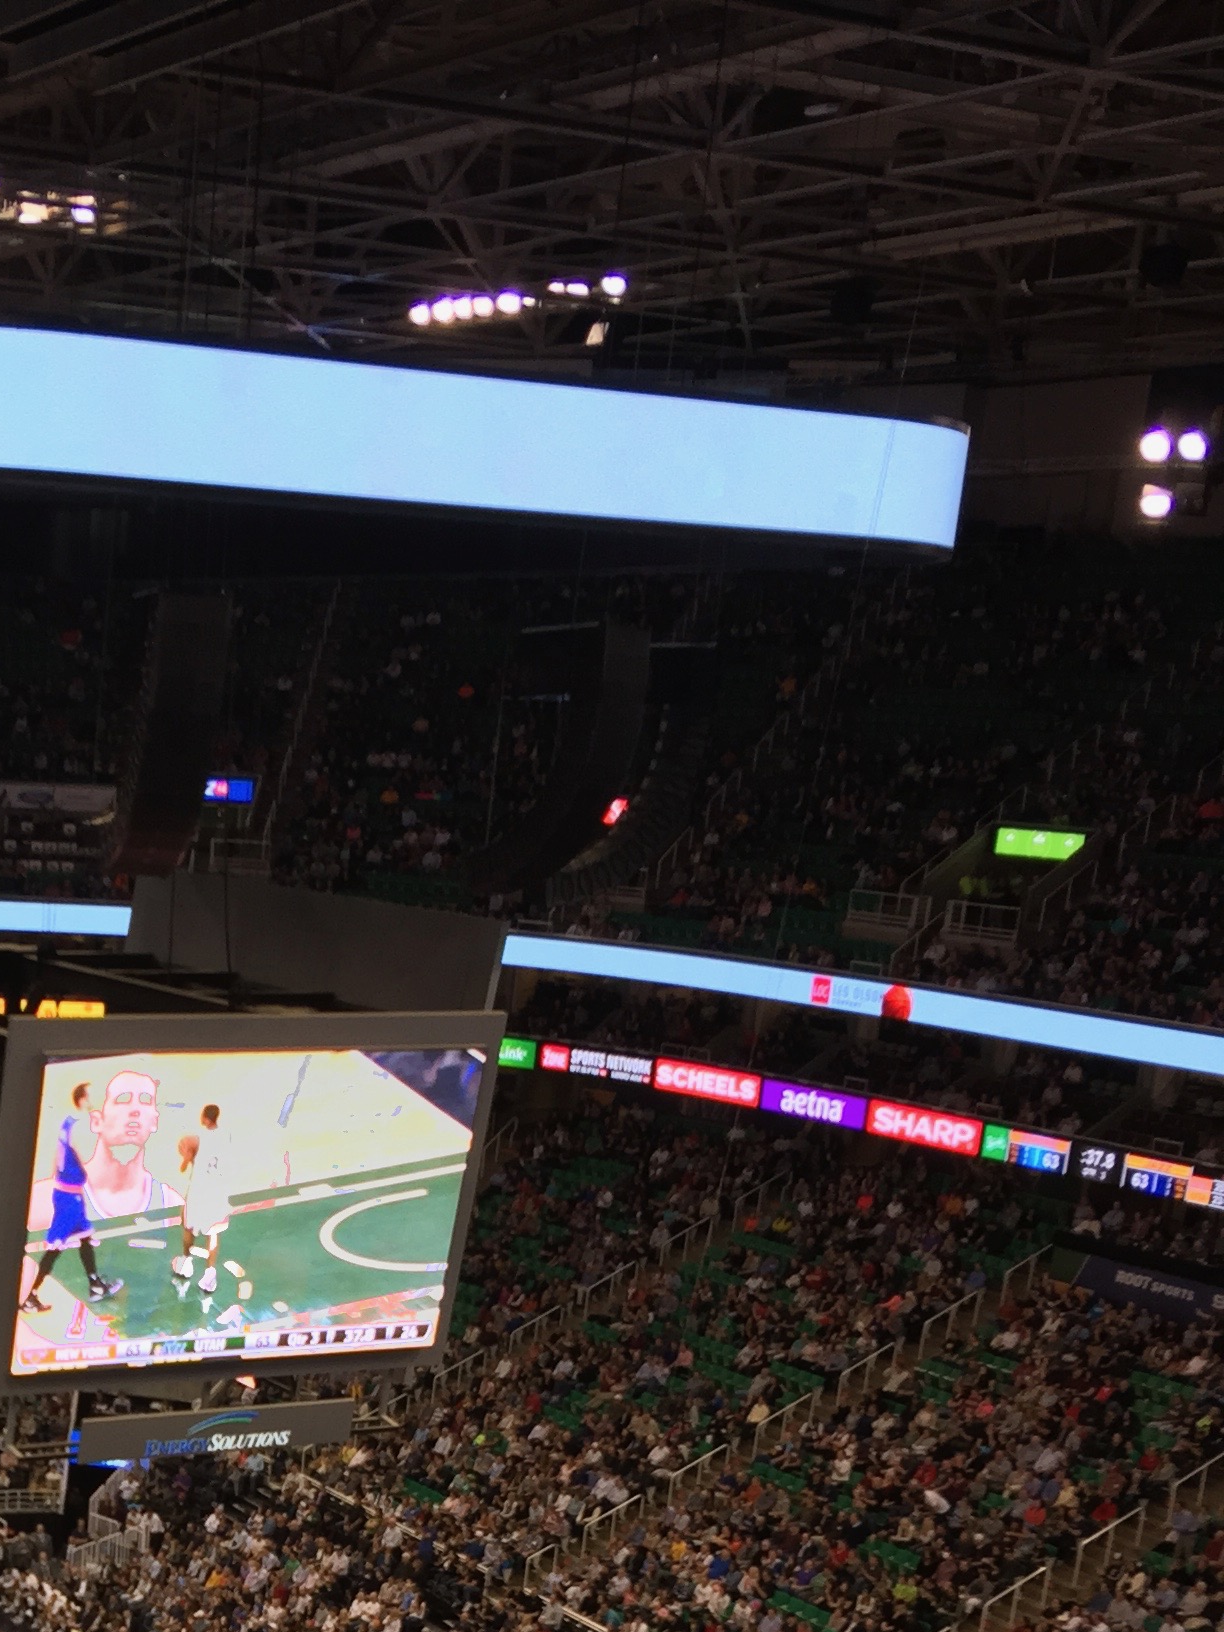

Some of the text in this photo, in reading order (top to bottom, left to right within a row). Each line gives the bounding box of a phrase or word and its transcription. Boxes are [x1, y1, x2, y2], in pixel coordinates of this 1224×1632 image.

[571, 1048, 653, 1077] SPORTS NETWORK
[656, 1064, 757, 1102] SCHEELS
[779, 1089, 845, 1124] aetna
[872, 1105, 975, 1150] SHARP
[1042, 1153, 1061, 1170] 63
[1130, 1172, 1149, 1189] 63
[1114, 1269, 1196, 1301] ROOT SPORTS
[344, 1328, 376, 1344] 37.8
[400, 1325, 418, 1340] 24
[193, 1338, 225, 1353] UTAH
[255, 1335, 271, 1349] 63
[56, 1347, 110, 1361] NEW YORK
